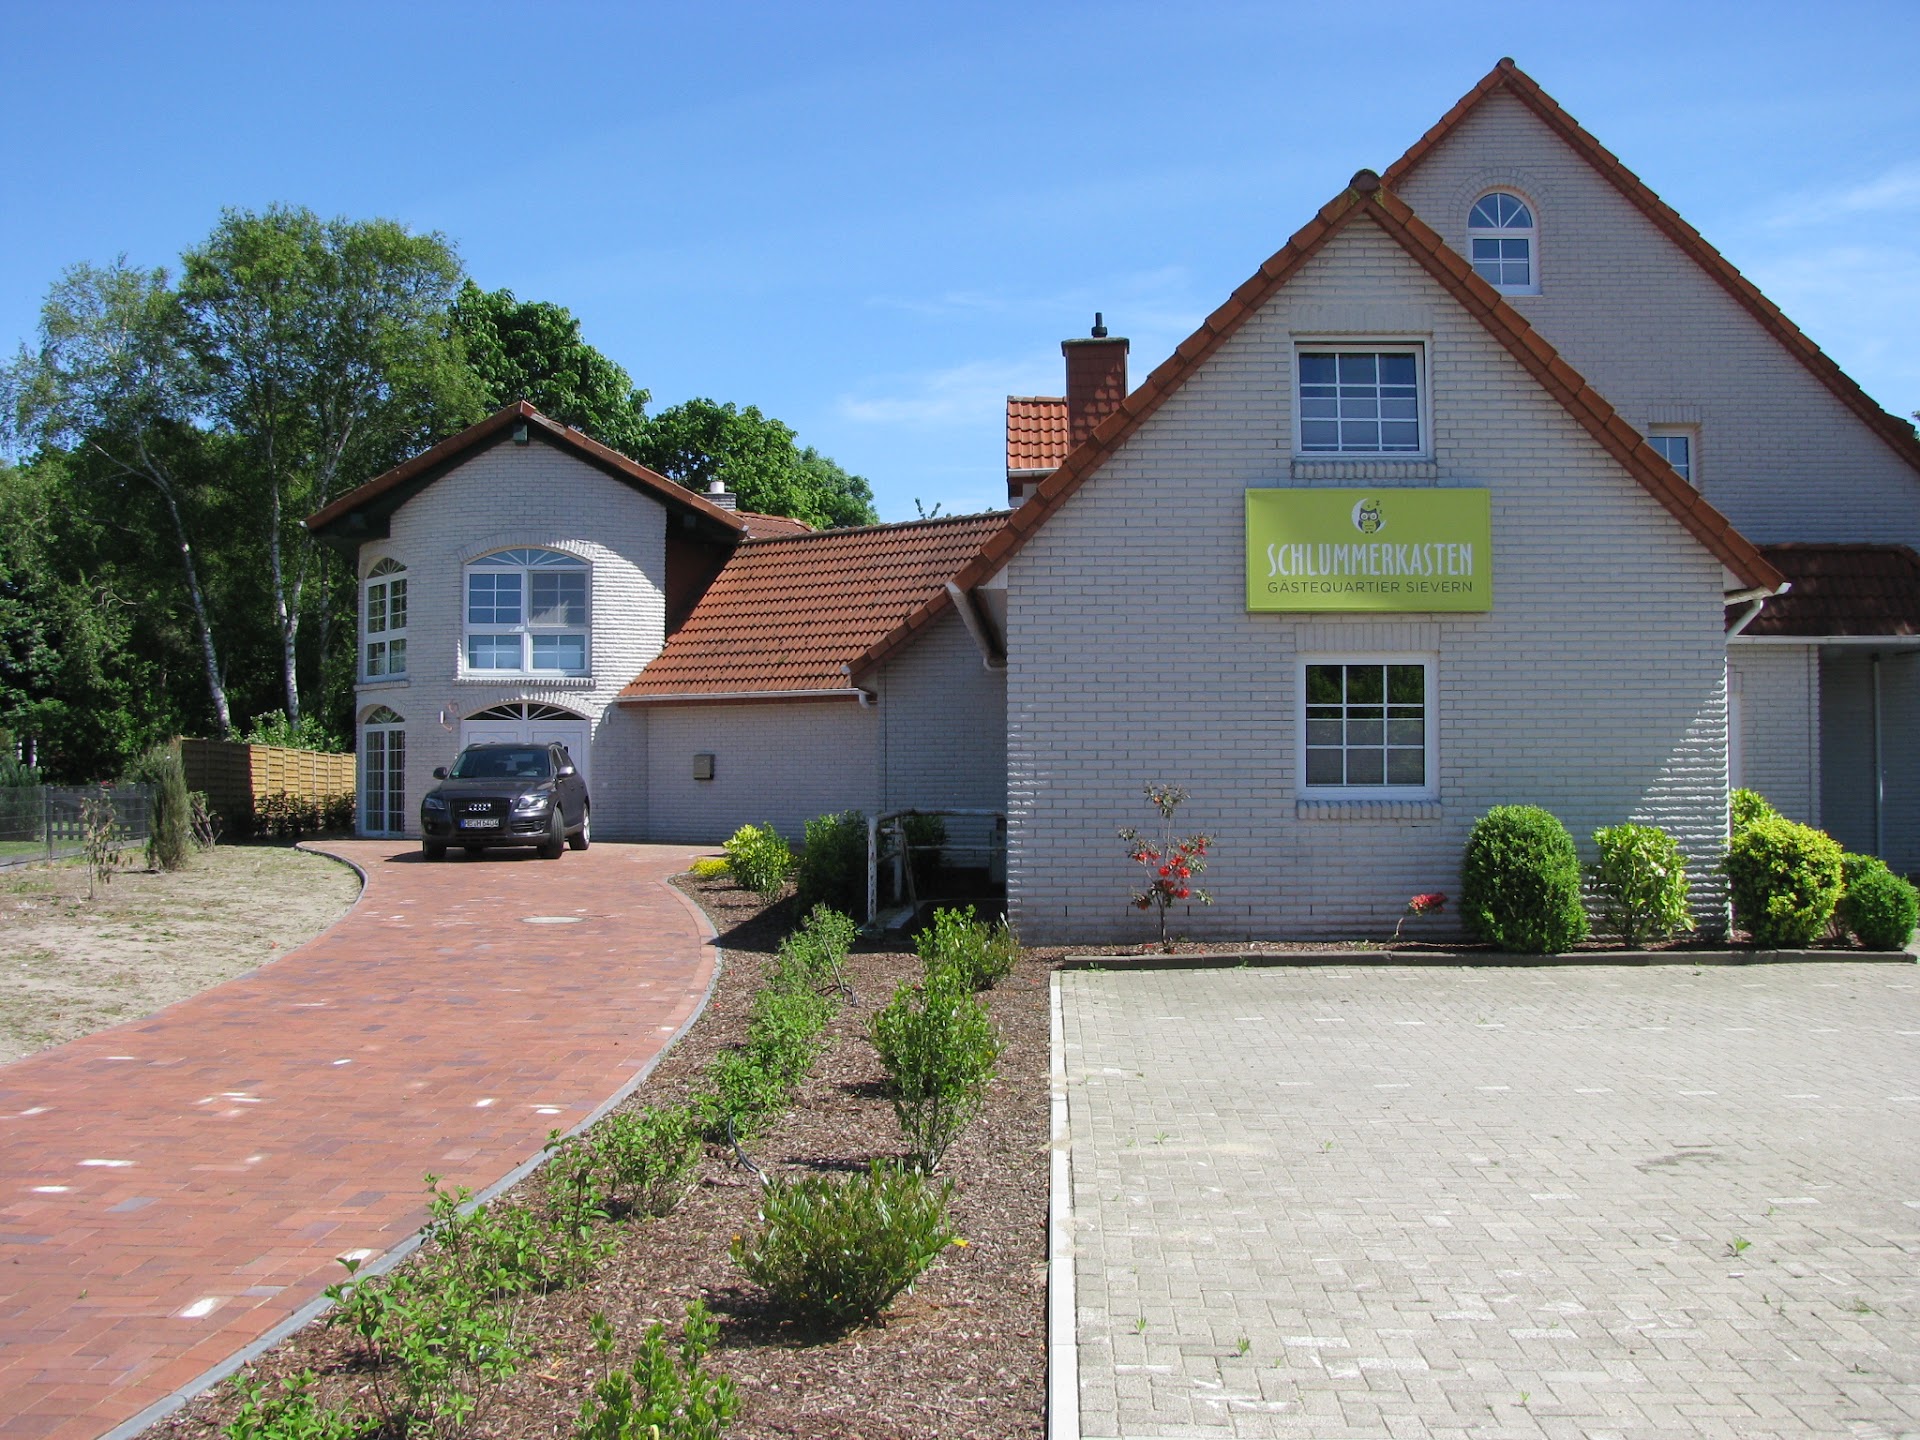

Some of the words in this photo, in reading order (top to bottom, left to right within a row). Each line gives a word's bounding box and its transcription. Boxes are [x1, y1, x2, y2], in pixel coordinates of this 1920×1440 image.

[1267, 543, 1473, 577] SCHLUMMERKASTEN
[1267, 579, 1400, 593] GÄSTEQUARTIER
[1406, 581, 1473, 593] SIEVERN
